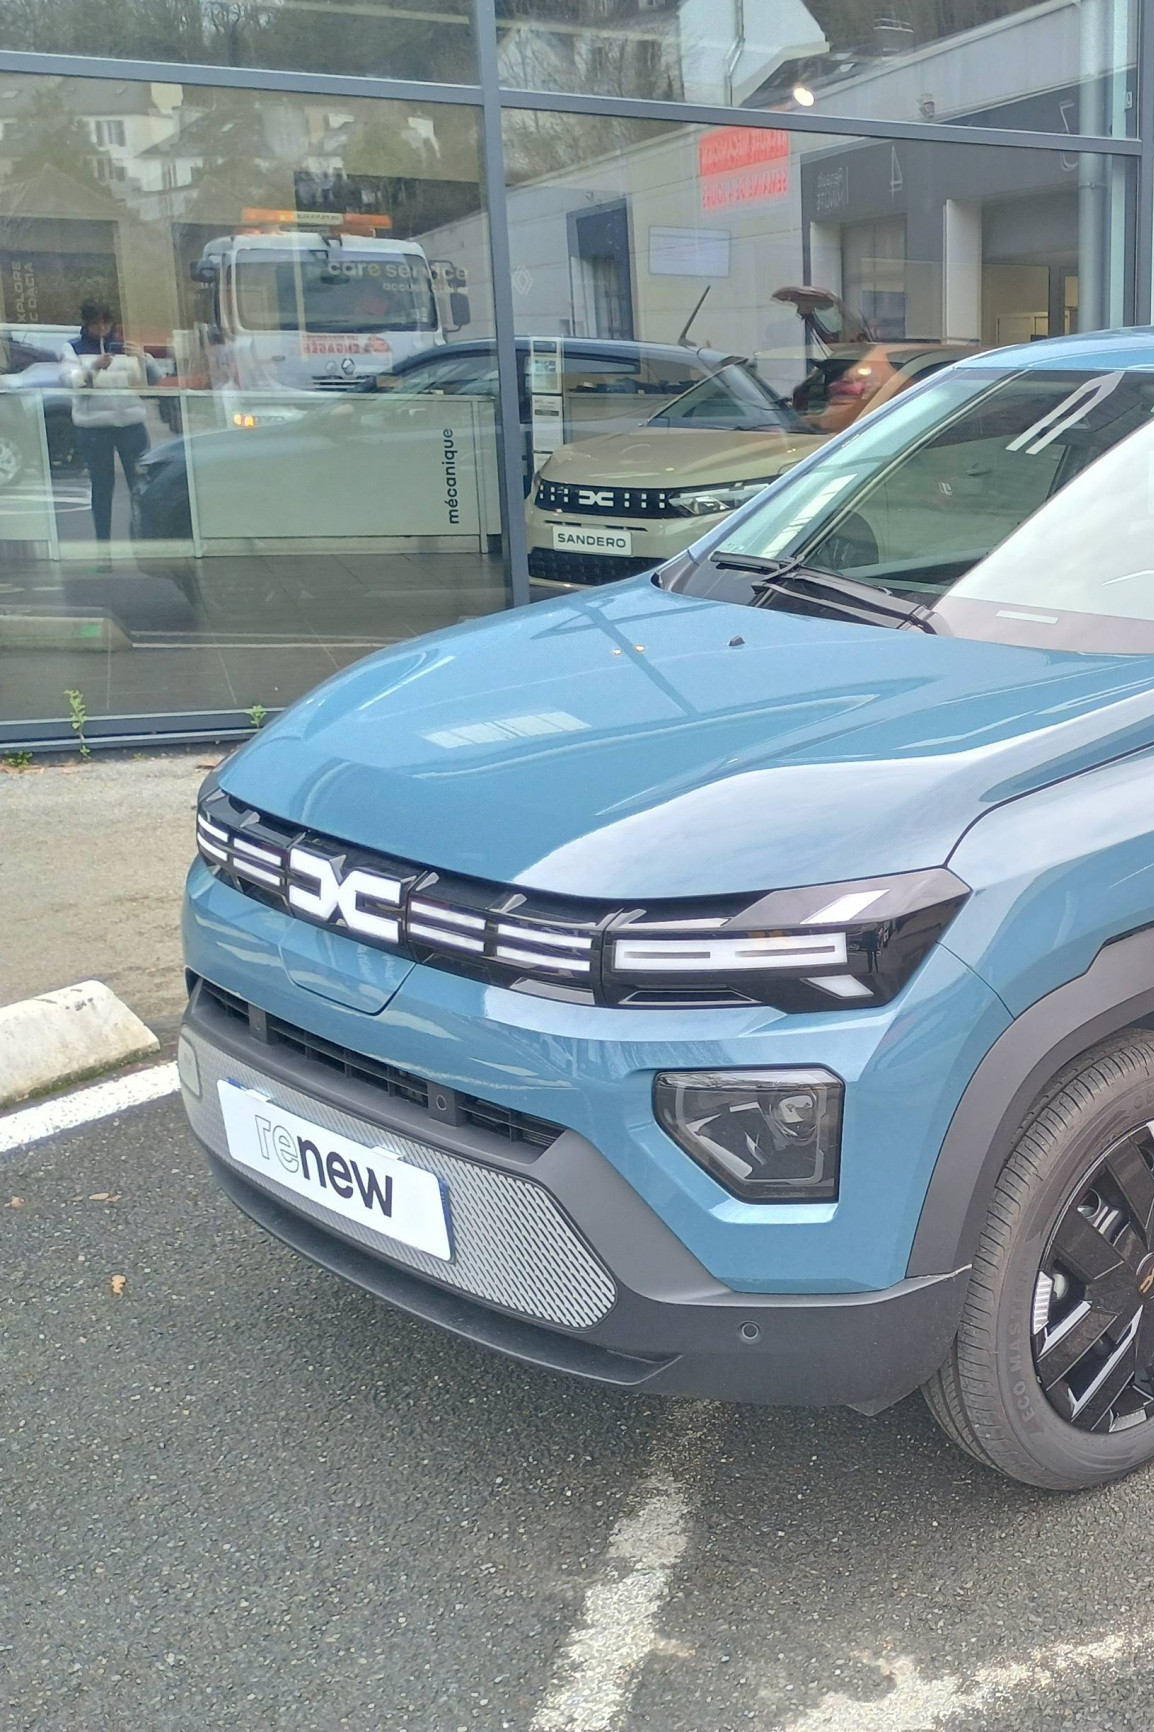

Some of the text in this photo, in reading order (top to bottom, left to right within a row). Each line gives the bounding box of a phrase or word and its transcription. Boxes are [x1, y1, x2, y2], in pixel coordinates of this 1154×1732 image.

[11, 260, 27, 323] XPLORE
[328, 262, 381, 278] care
[442, 428, 459, 524] mécanique
[557, 533, 626, 548] SANDERO
[255, 1114, 393, 1218] renew
[1013, 1380, 1036, 1423] ECO
